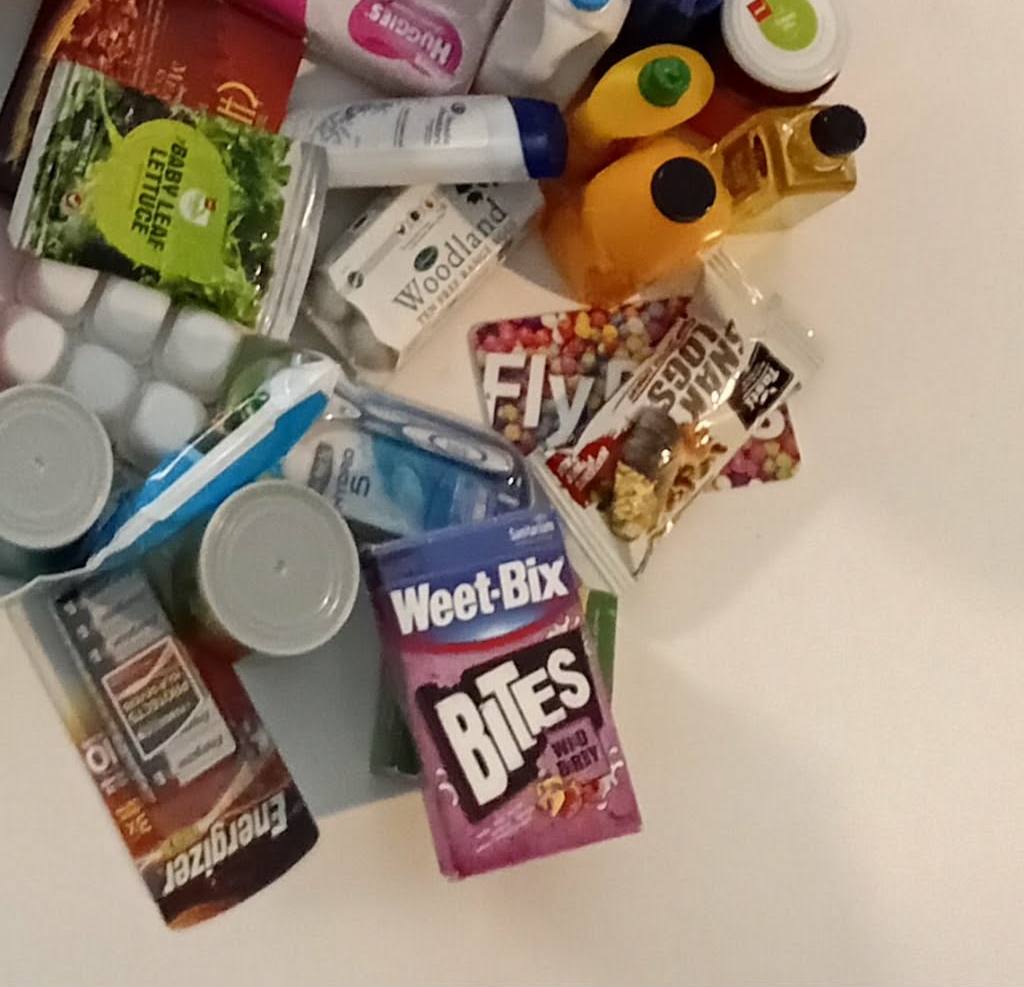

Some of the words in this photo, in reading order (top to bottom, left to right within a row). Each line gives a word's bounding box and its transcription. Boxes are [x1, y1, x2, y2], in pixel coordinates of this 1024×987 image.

[368, 2, 453, 65] HUGGIES
[131, 147, 168, 235] LETTUCE
[162, 142, 189, 198] BABY
[147, 199, 175, 252] LEAF
[392, 197, 508, 311] Woodland
[483, 350, 594, 450] Fly
[646, 322, 718, 415] LOGS
[389, 555, 570, 637] Weet-Bix
[162, 791, 289, 897] Energizer
